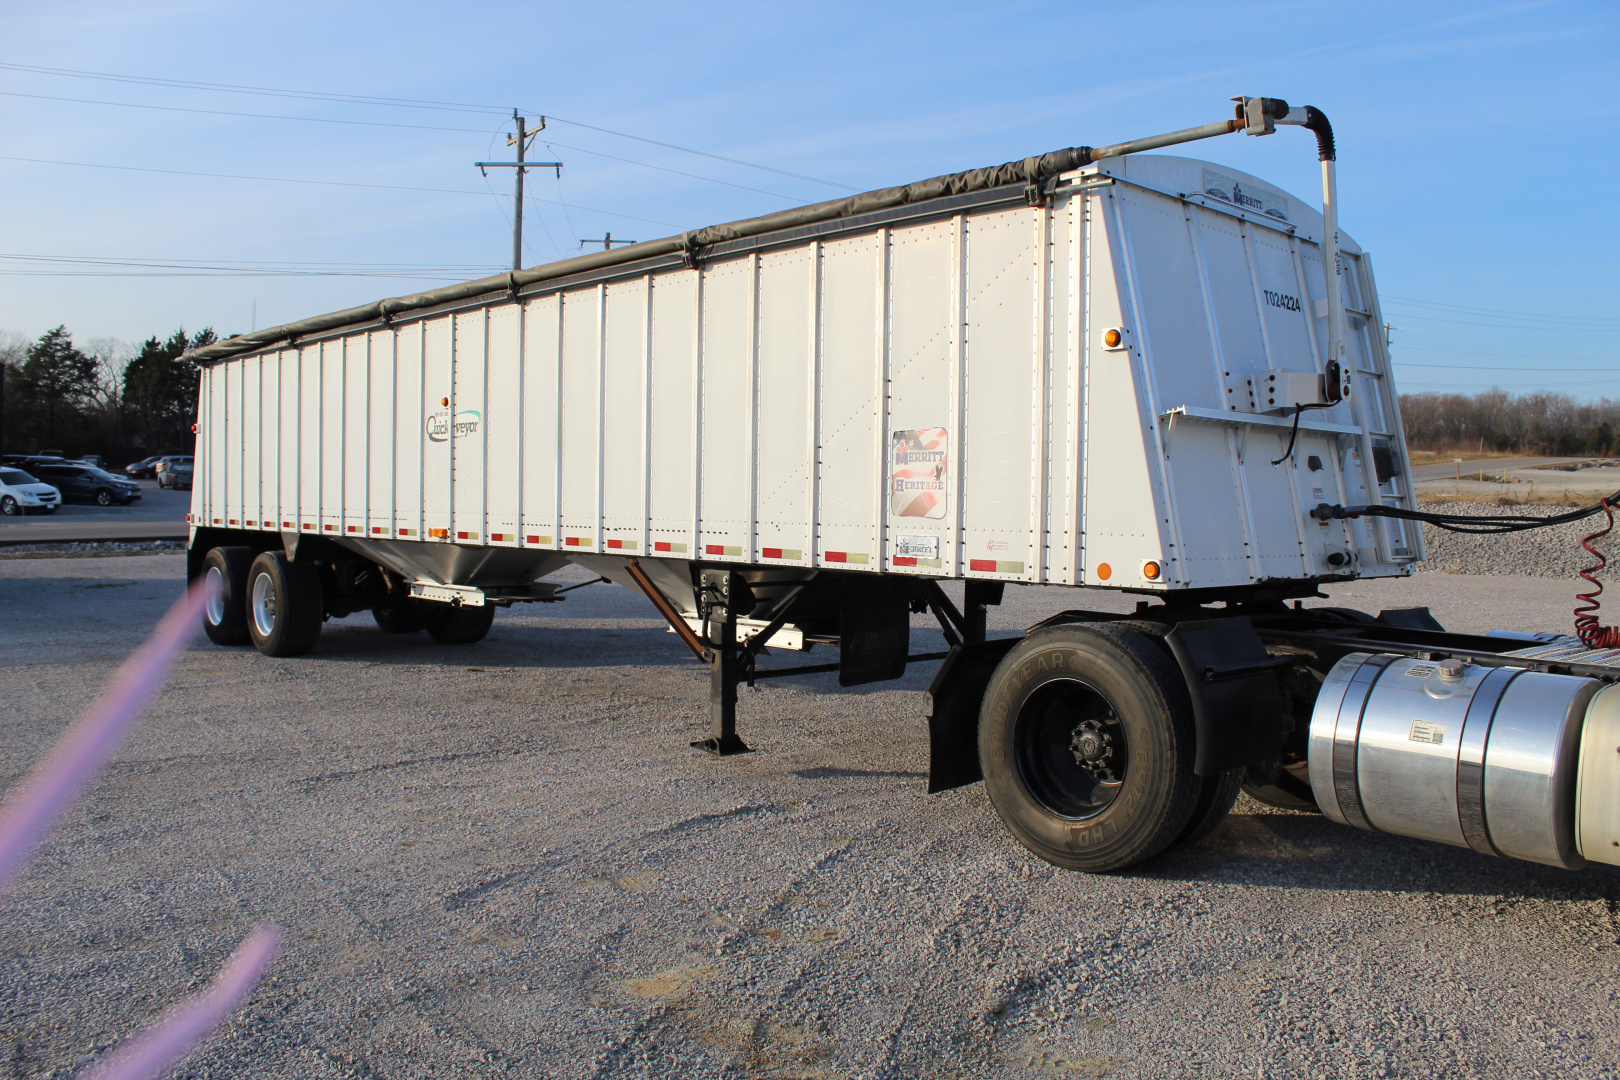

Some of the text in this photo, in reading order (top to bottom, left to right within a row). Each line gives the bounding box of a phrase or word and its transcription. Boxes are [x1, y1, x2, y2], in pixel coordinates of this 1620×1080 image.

[1263, 289, 1301, 312] T024224
[895, 451, 945, 465] MERRITT
[895, 479, 944, 492] HERITAGE
[991, 652, 1065, 764] GOODYEAR
